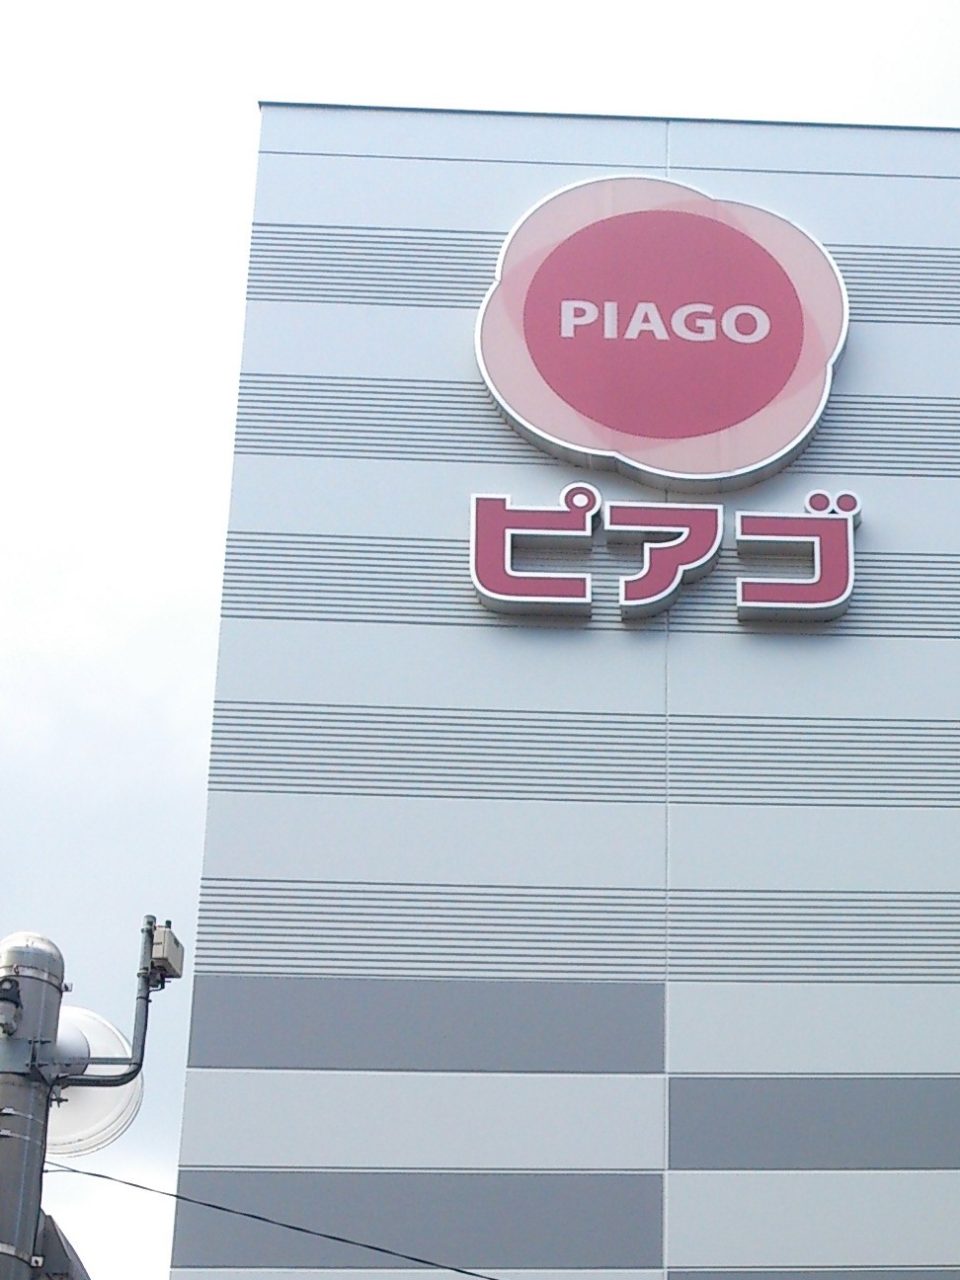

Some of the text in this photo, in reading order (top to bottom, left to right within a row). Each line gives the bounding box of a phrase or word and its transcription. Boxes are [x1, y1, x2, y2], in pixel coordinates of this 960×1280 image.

[559, 299, 771, 344] PIAGO
[471, 482, 862, 606] ピアゴ
